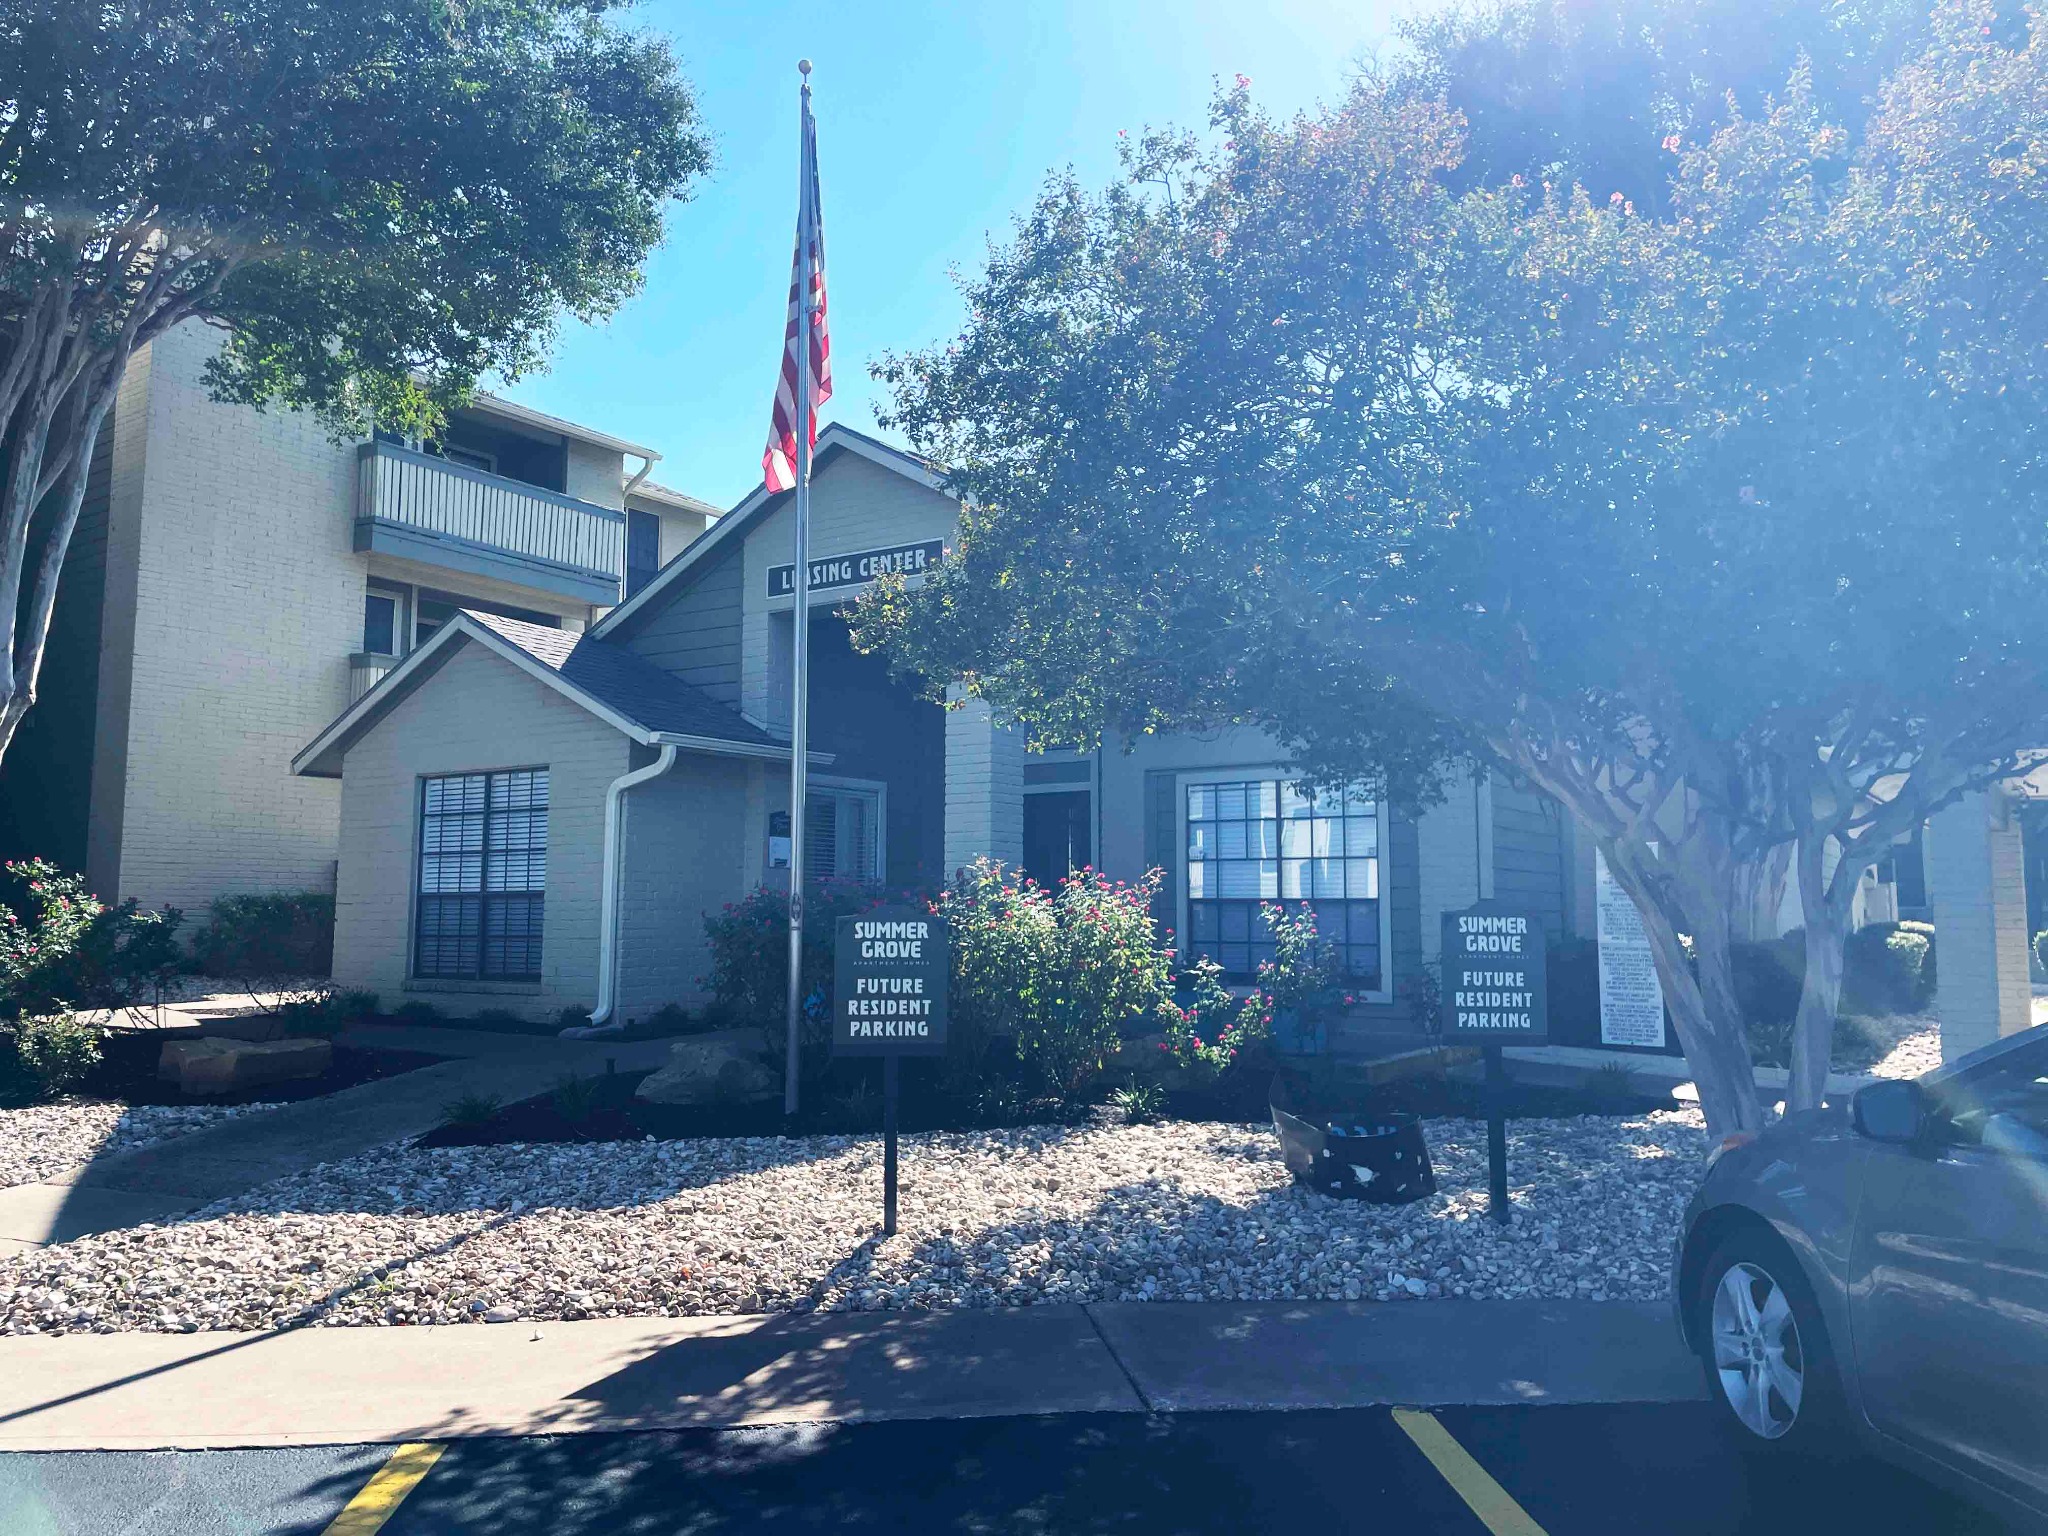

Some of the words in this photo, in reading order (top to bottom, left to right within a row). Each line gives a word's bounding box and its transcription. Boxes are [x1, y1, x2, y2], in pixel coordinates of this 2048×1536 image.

[859, 549, 926, 577] CENTER
[854, 921, 929, 939] SUMMER
[1458, 916, 1528, 934] SUMMER
[861, 940, 922, 958] GROVE
[1466, 935, 1522, 952] GROVE
[856, 978, 924, 994] FUTURE
[1463, 971, 1525, 987] FUTURE
[847, 999, 932, 1015] RESIDENT
[1455, 991, 1533, 1008] RESIDENT
[1458, 1012, 1531, 1028] PARKING
[850, 1021, 929, 1037] PARKING
